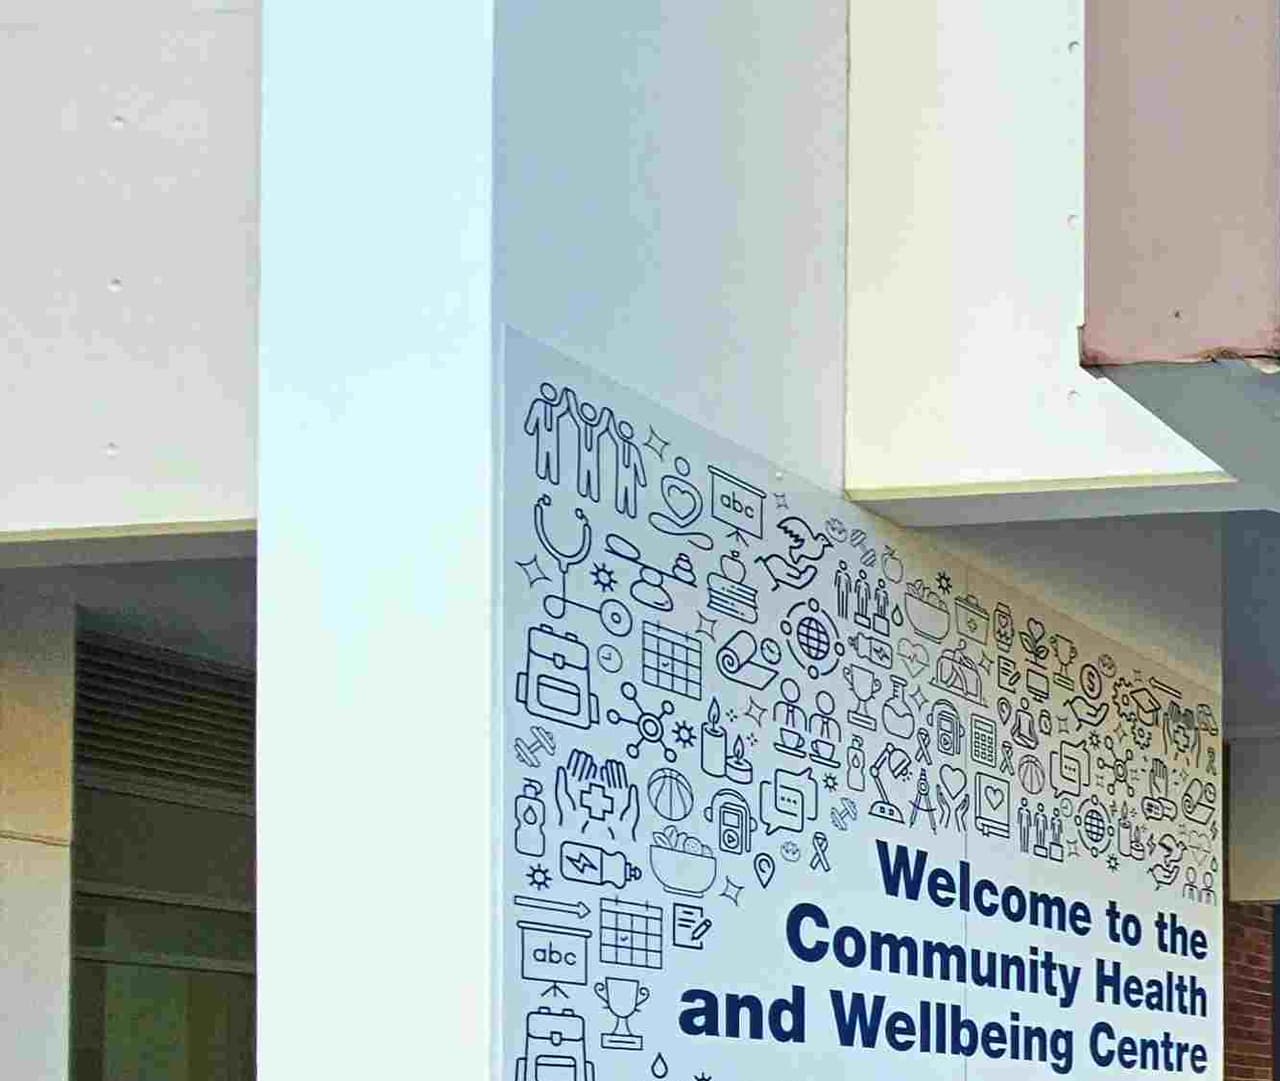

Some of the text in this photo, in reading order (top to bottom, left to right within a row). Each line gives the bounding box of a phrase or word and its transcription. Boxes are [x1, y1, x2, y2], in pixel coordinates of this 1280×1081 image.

[720, 491, 754, 518] abc
[876, 839, 1208, 960] Welcome to the
[533, 941, 577, 966] abc
[786, 903, 1207, 1018] Community Health
[678, 985, 1207, 1075] and Wellbeing Centre
